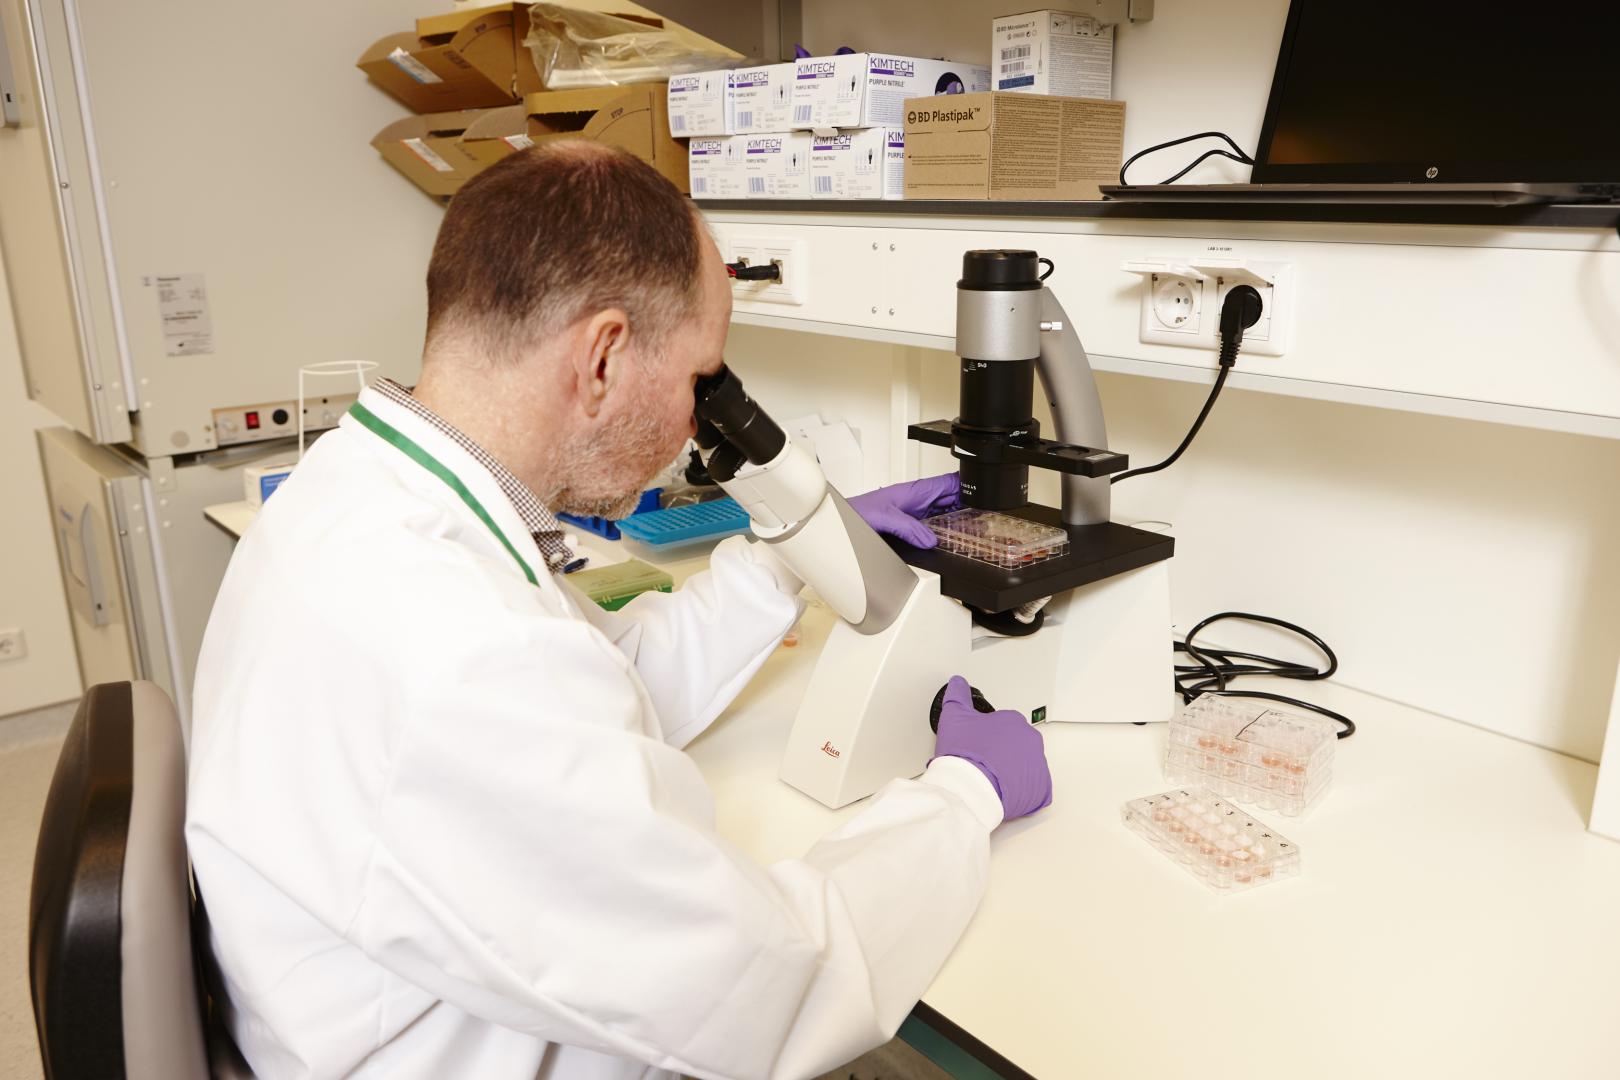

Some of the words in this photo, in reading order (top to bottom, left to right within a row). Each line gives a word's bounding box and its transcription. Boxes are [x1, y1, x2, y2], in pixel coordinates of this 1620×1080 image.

[797, 61, 835, 74] KIMTECH
[870, 57, 914, 71] KIMTECH
[671, 77, 700, 87] KIMTECH
[736, 71, 768, 82] KIMTECH
[918, 111, 930, 123] BD
[747, 138, 782, 149] KIMTECH
[813, 134, 852, 145] KIMTECH
[692, 141, 722, 151] KIMTECH
[821, 741, 840, 758] Leica
